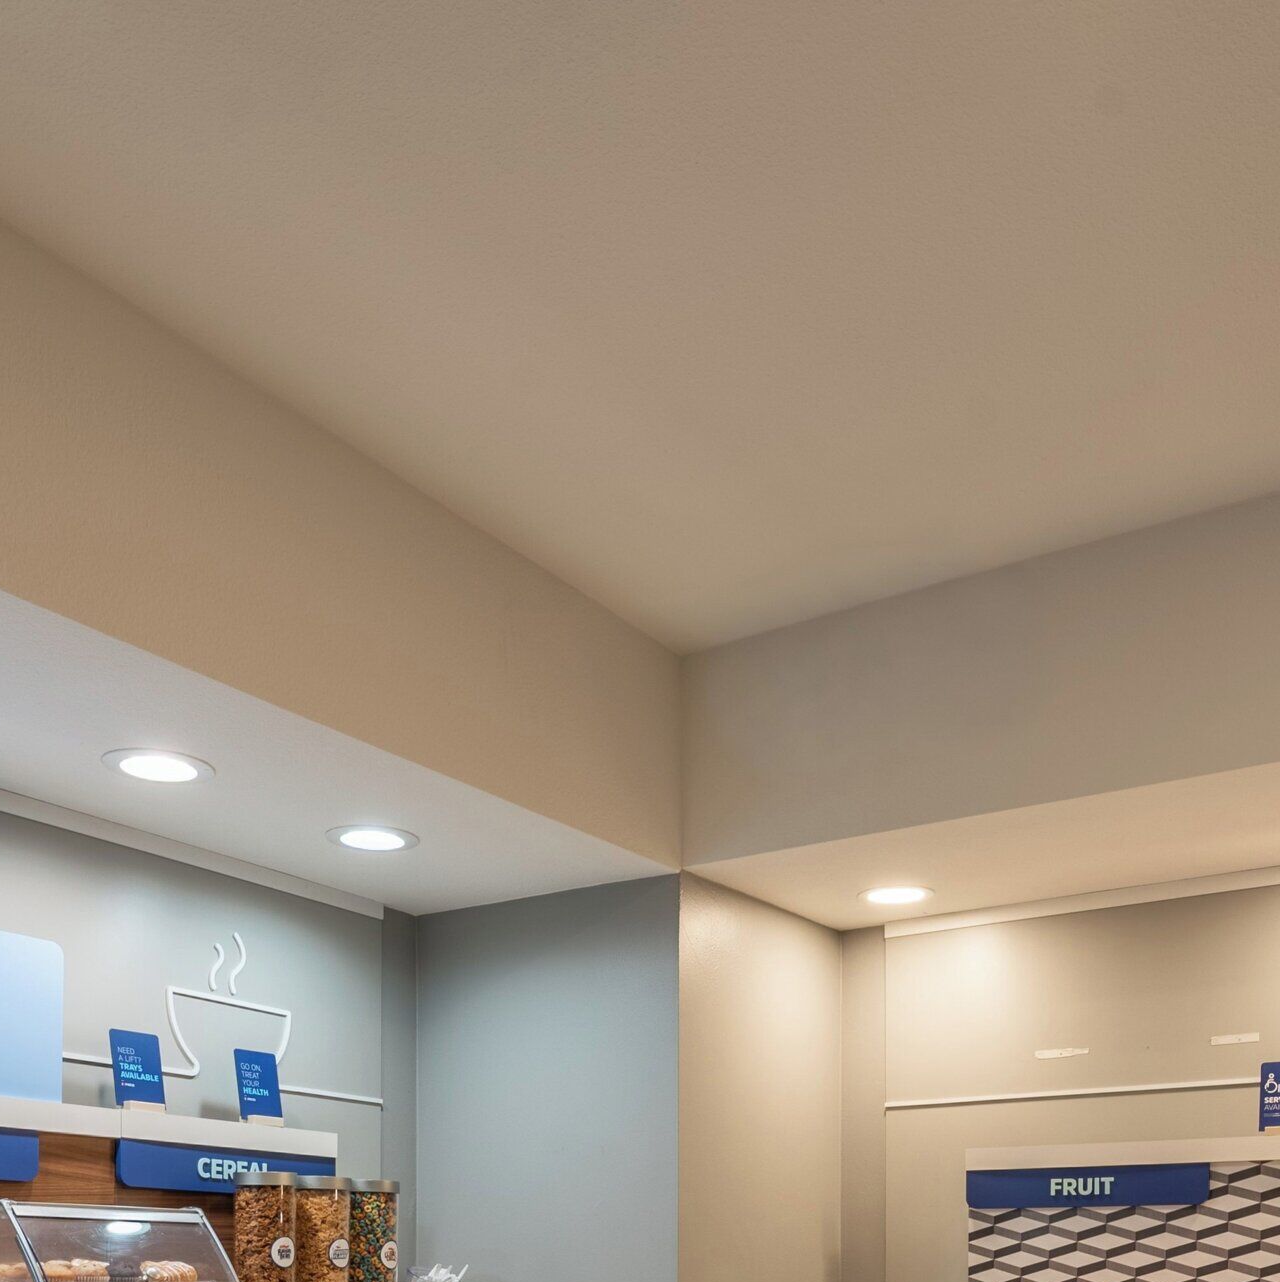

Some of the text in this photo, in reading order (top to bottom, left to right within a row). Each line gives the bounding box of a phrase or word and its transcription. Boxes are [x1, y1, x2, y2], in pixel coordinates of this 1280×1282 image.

[117, 1046, 136, 1055] NEED
[118, 1054, 142, 1064] A LIFT?
[119, 1062, 143, 1072] TRAYS
[240, 1062, 250, 1070] GO
[120, 1070, 160, 1082] AVAILABLE
[240, 1070, 260, 1079] TREAT
[241, 1078, 260, 1087] YOUR
[242, 1086, 269, 1097] HEALTH
[1049, 1176, 1115, 1196] FRUIT
